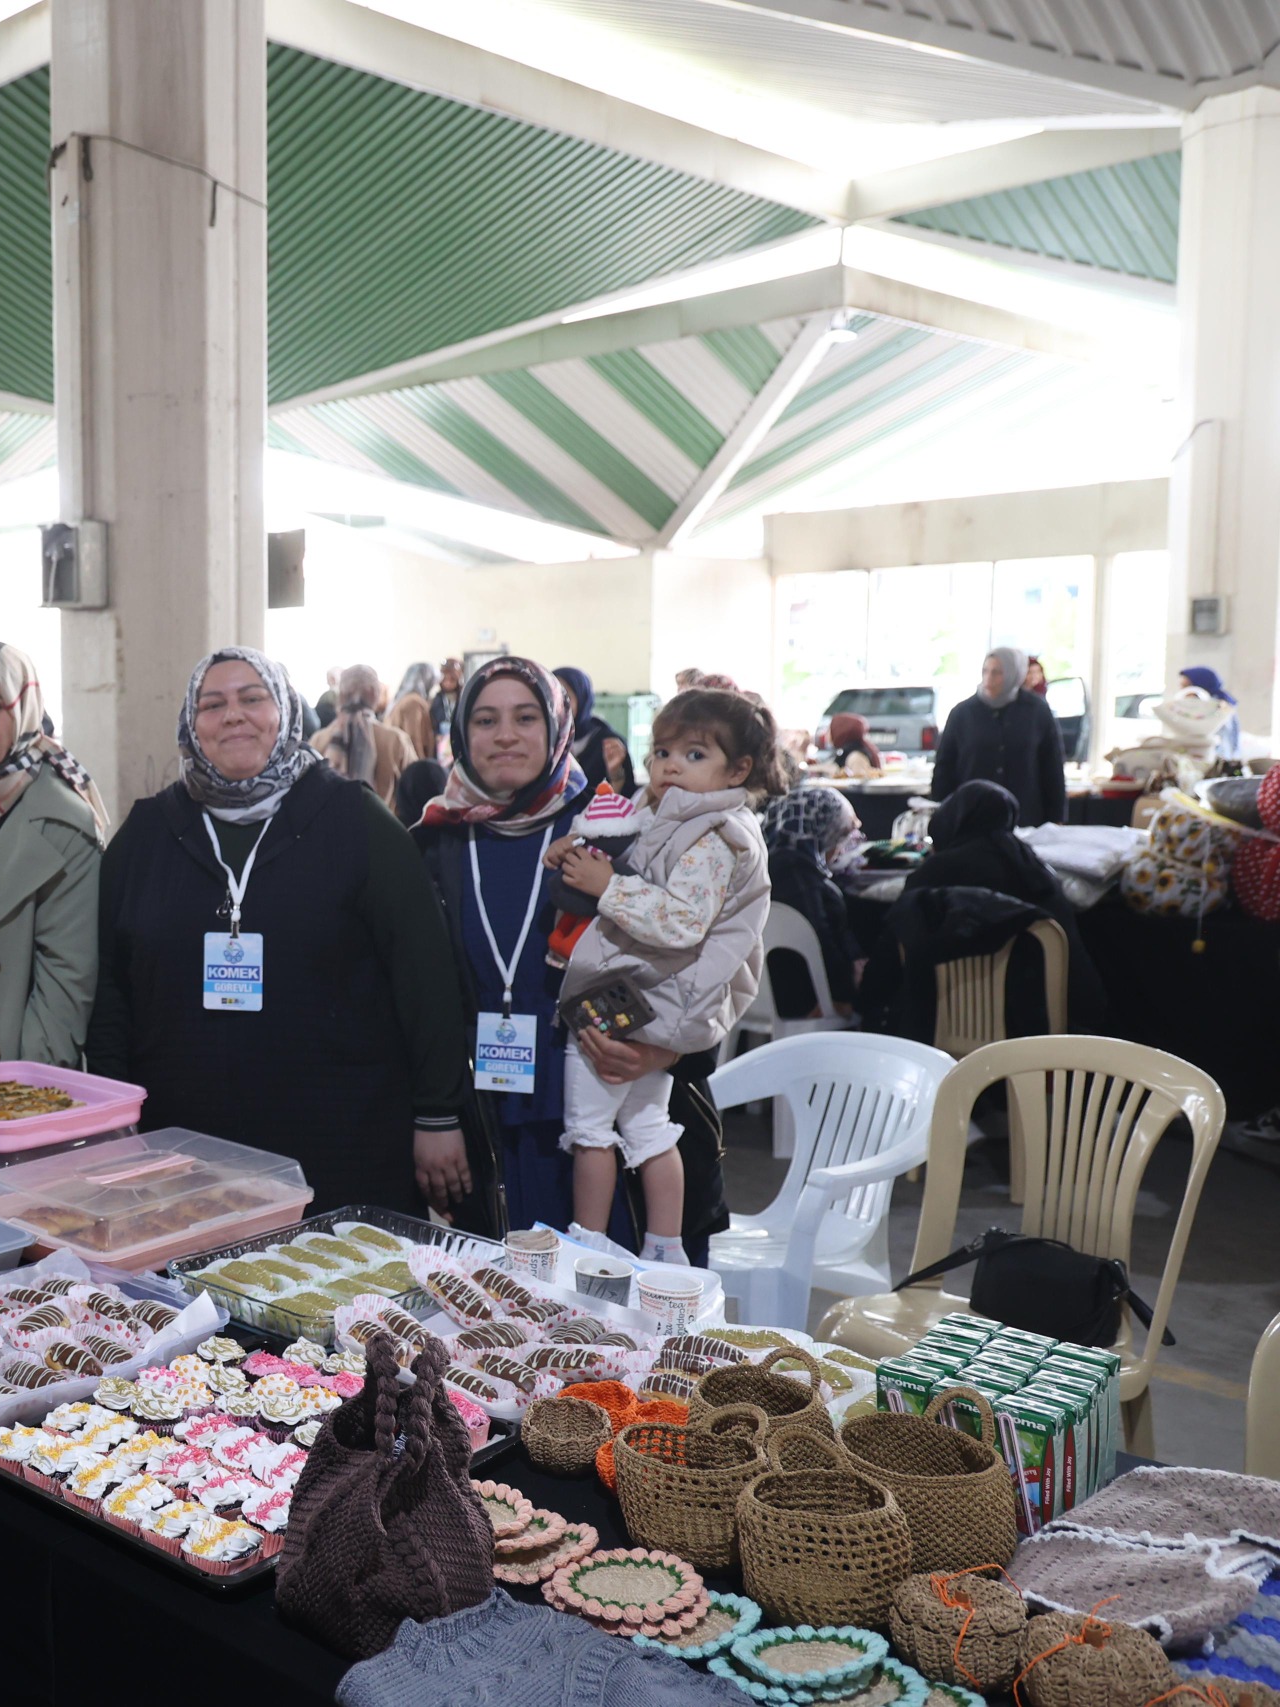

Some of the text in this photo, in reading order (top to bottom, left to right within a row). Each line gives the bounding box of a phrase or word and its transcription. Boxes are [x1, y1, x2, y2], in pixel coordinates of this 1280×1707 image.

[207, 967, 259, 979] KOMEK
[479, 1046, 531, 1060] KOMEK
[669, 1300, 686, 1309] tea
[878, 1374, 926, 1393] aroma
[950, 1400, 981, 1414] oma
[1013, 1416, 1047, 1432] oma
